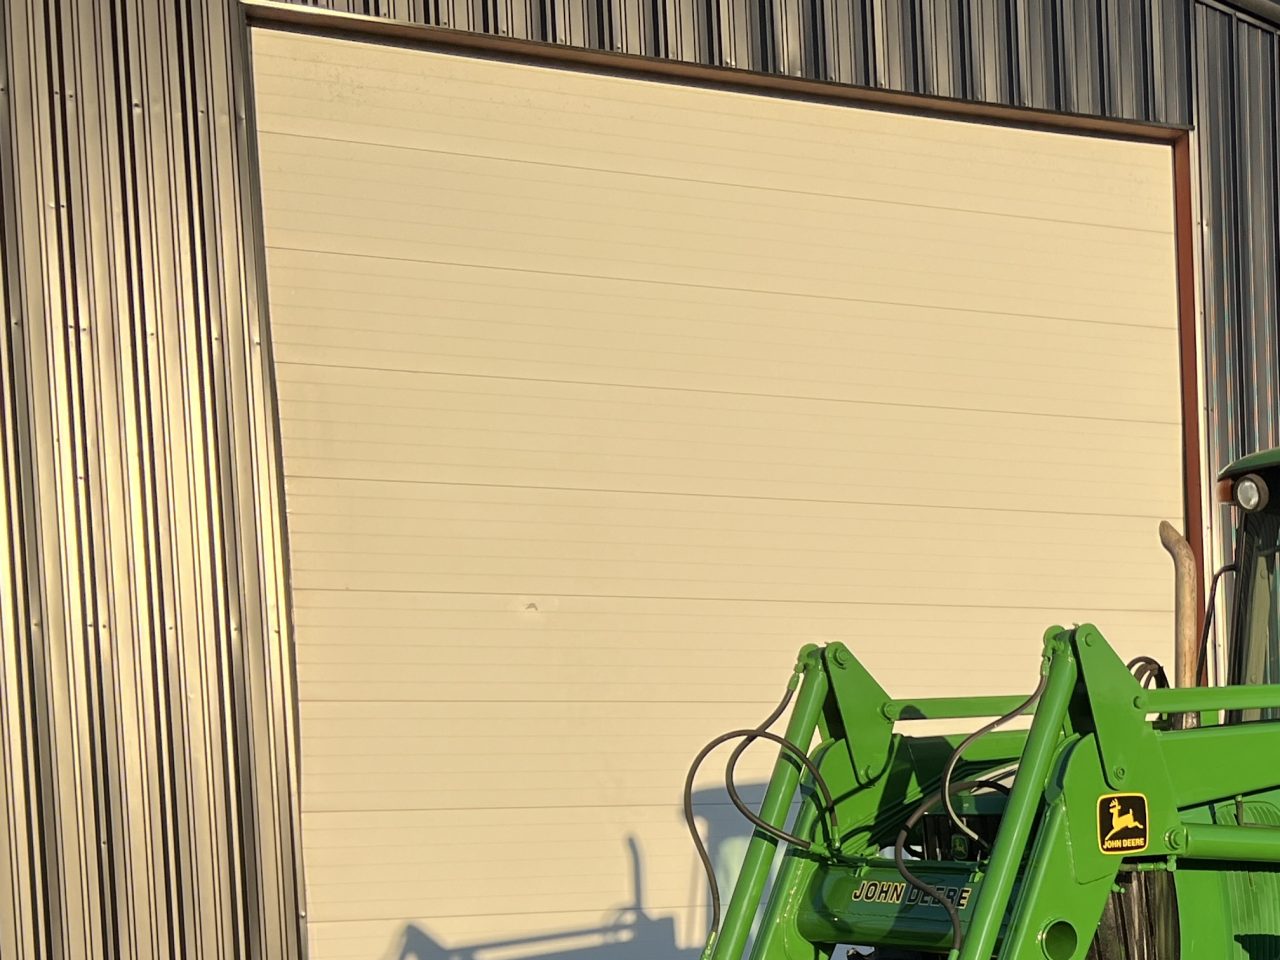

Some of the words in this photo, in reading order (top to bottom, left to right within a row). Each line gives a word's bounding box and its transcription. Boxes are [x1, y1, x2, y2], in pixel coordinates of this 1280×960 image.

[1103, 840, 1122, 849] JOHN
[1122, 838, 1145, 847] DEERE
[852, 880, 906, 904] JOHN
